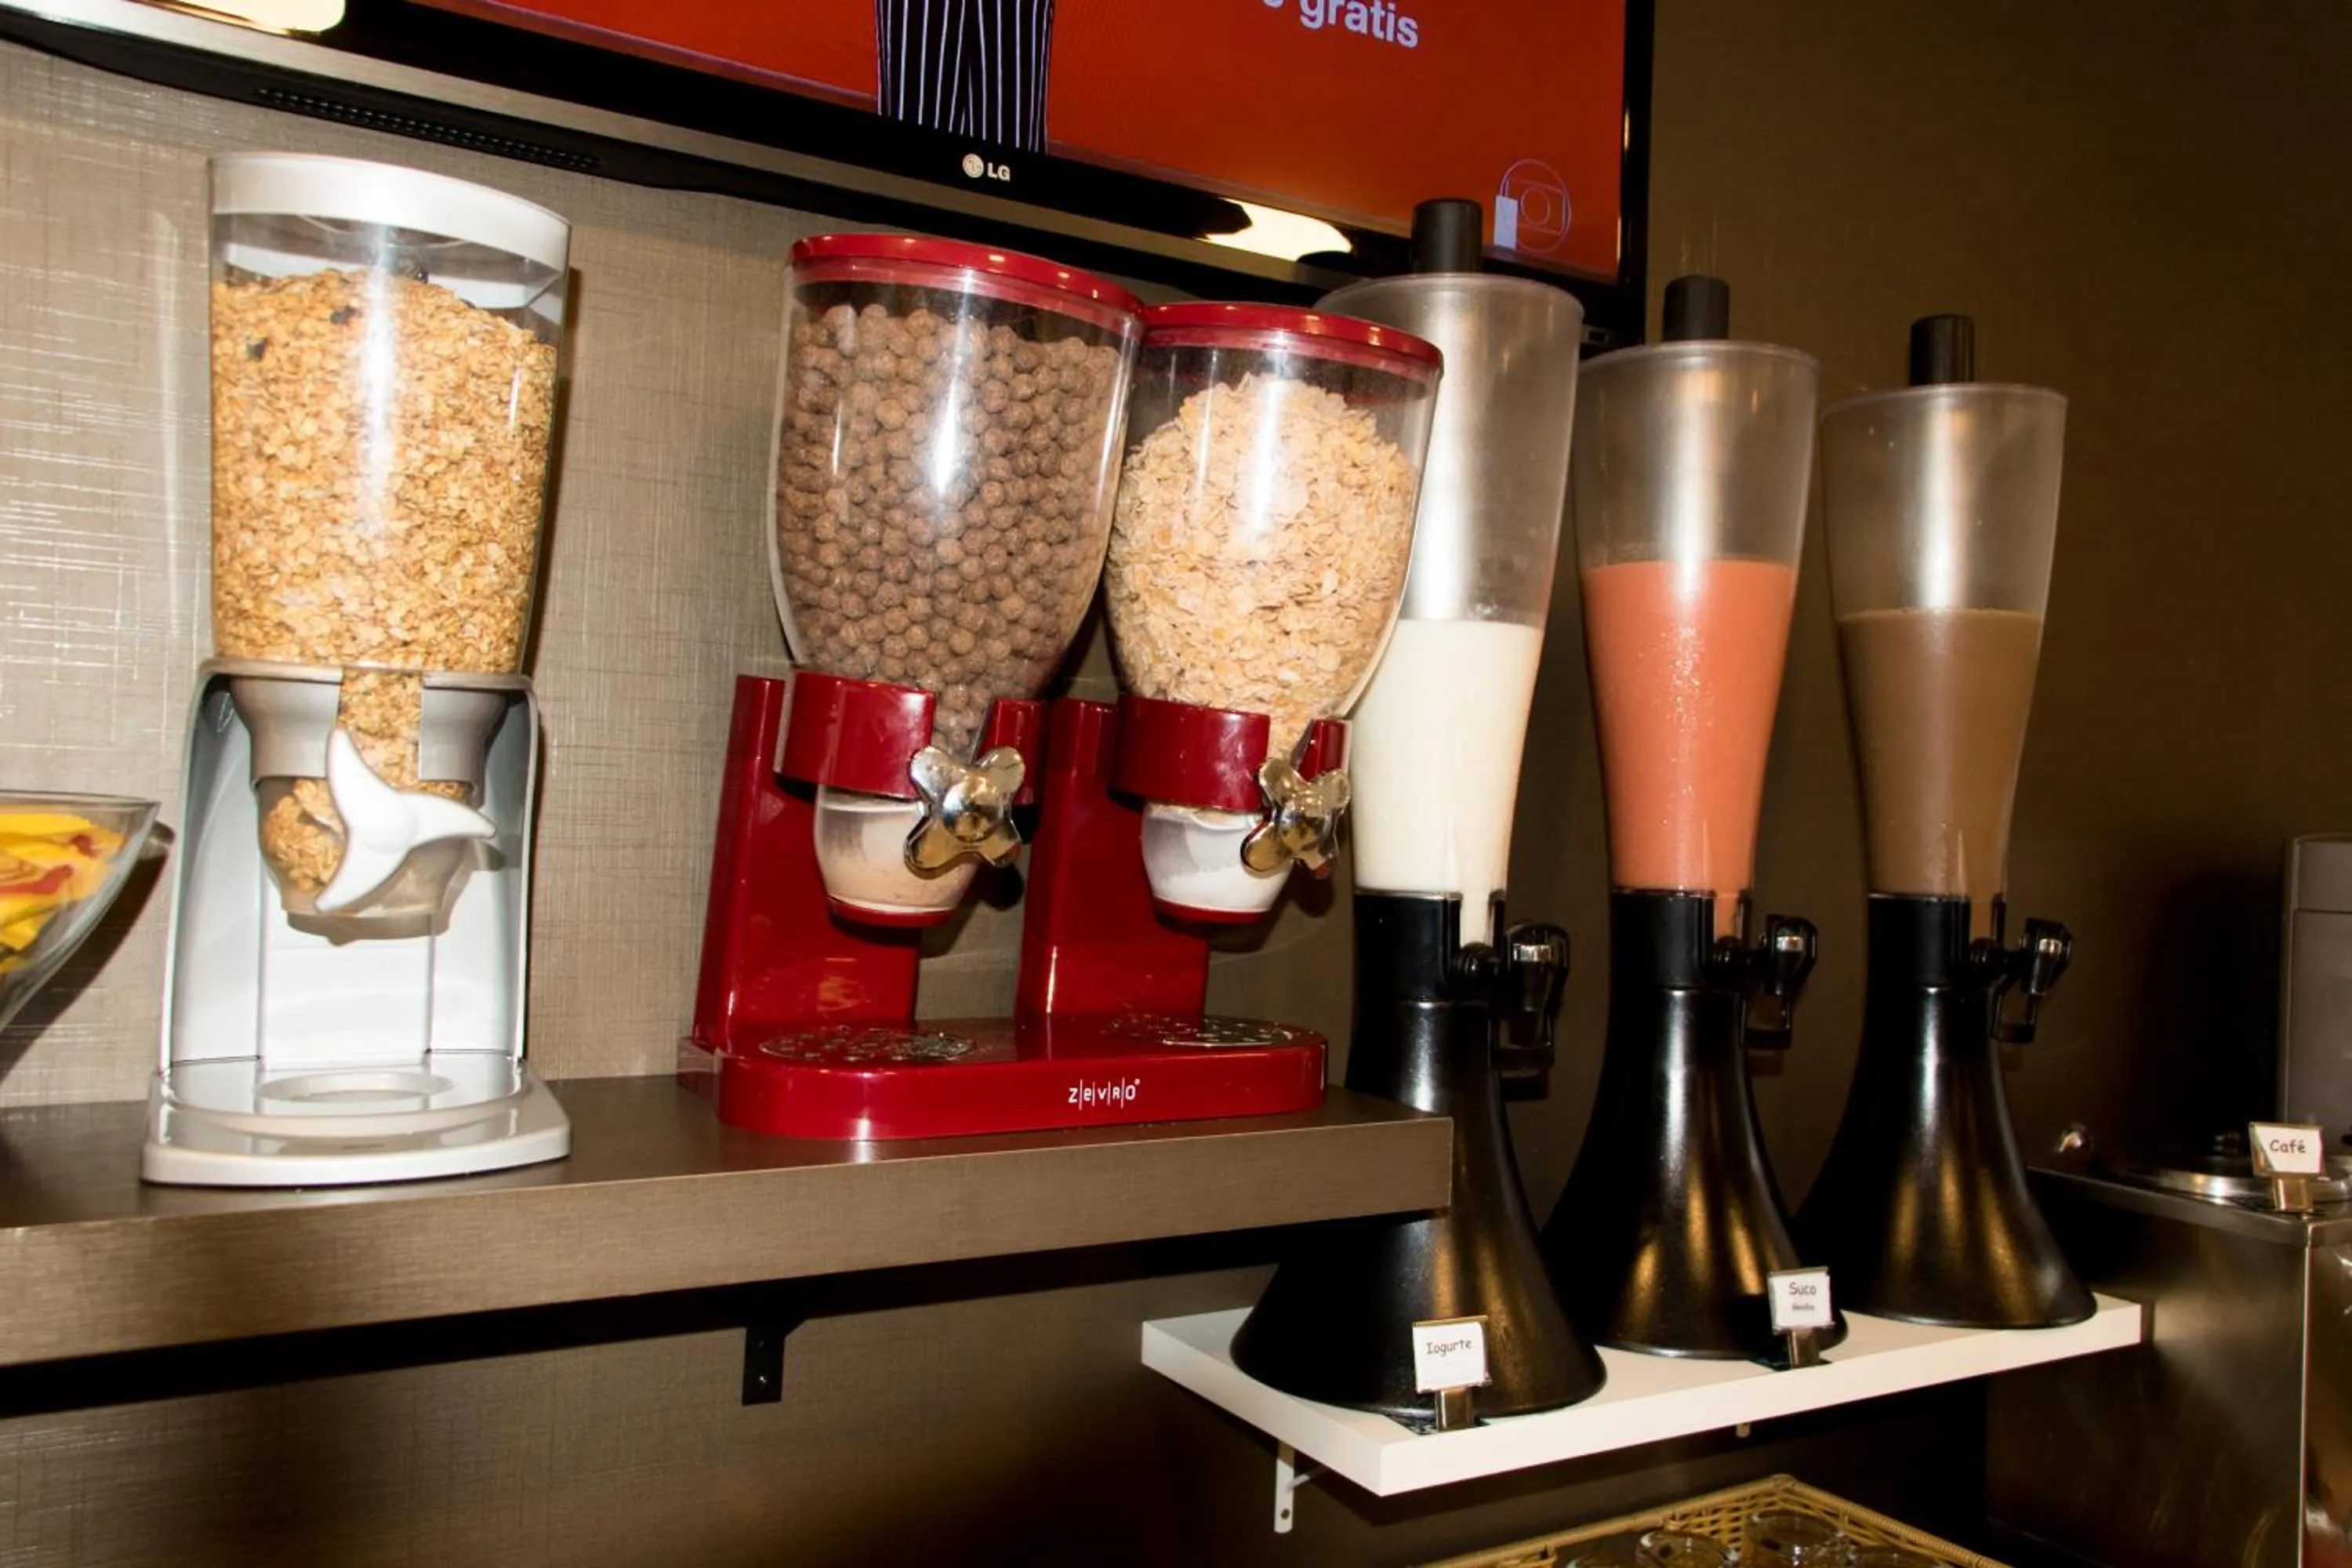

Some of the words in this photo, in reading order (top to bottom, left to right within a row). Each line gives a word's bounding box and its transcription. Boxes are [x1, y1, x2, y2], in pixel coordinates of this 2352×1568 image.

[1299, 0, 1418, 48] gratis
[988, 162, 1011, 183] LG
[2270, 1139, 2307, 1154] Café
[1789, 1281, 1817, 1295] Suco
[1427, 1339, 1472, 1356] Iogurte
